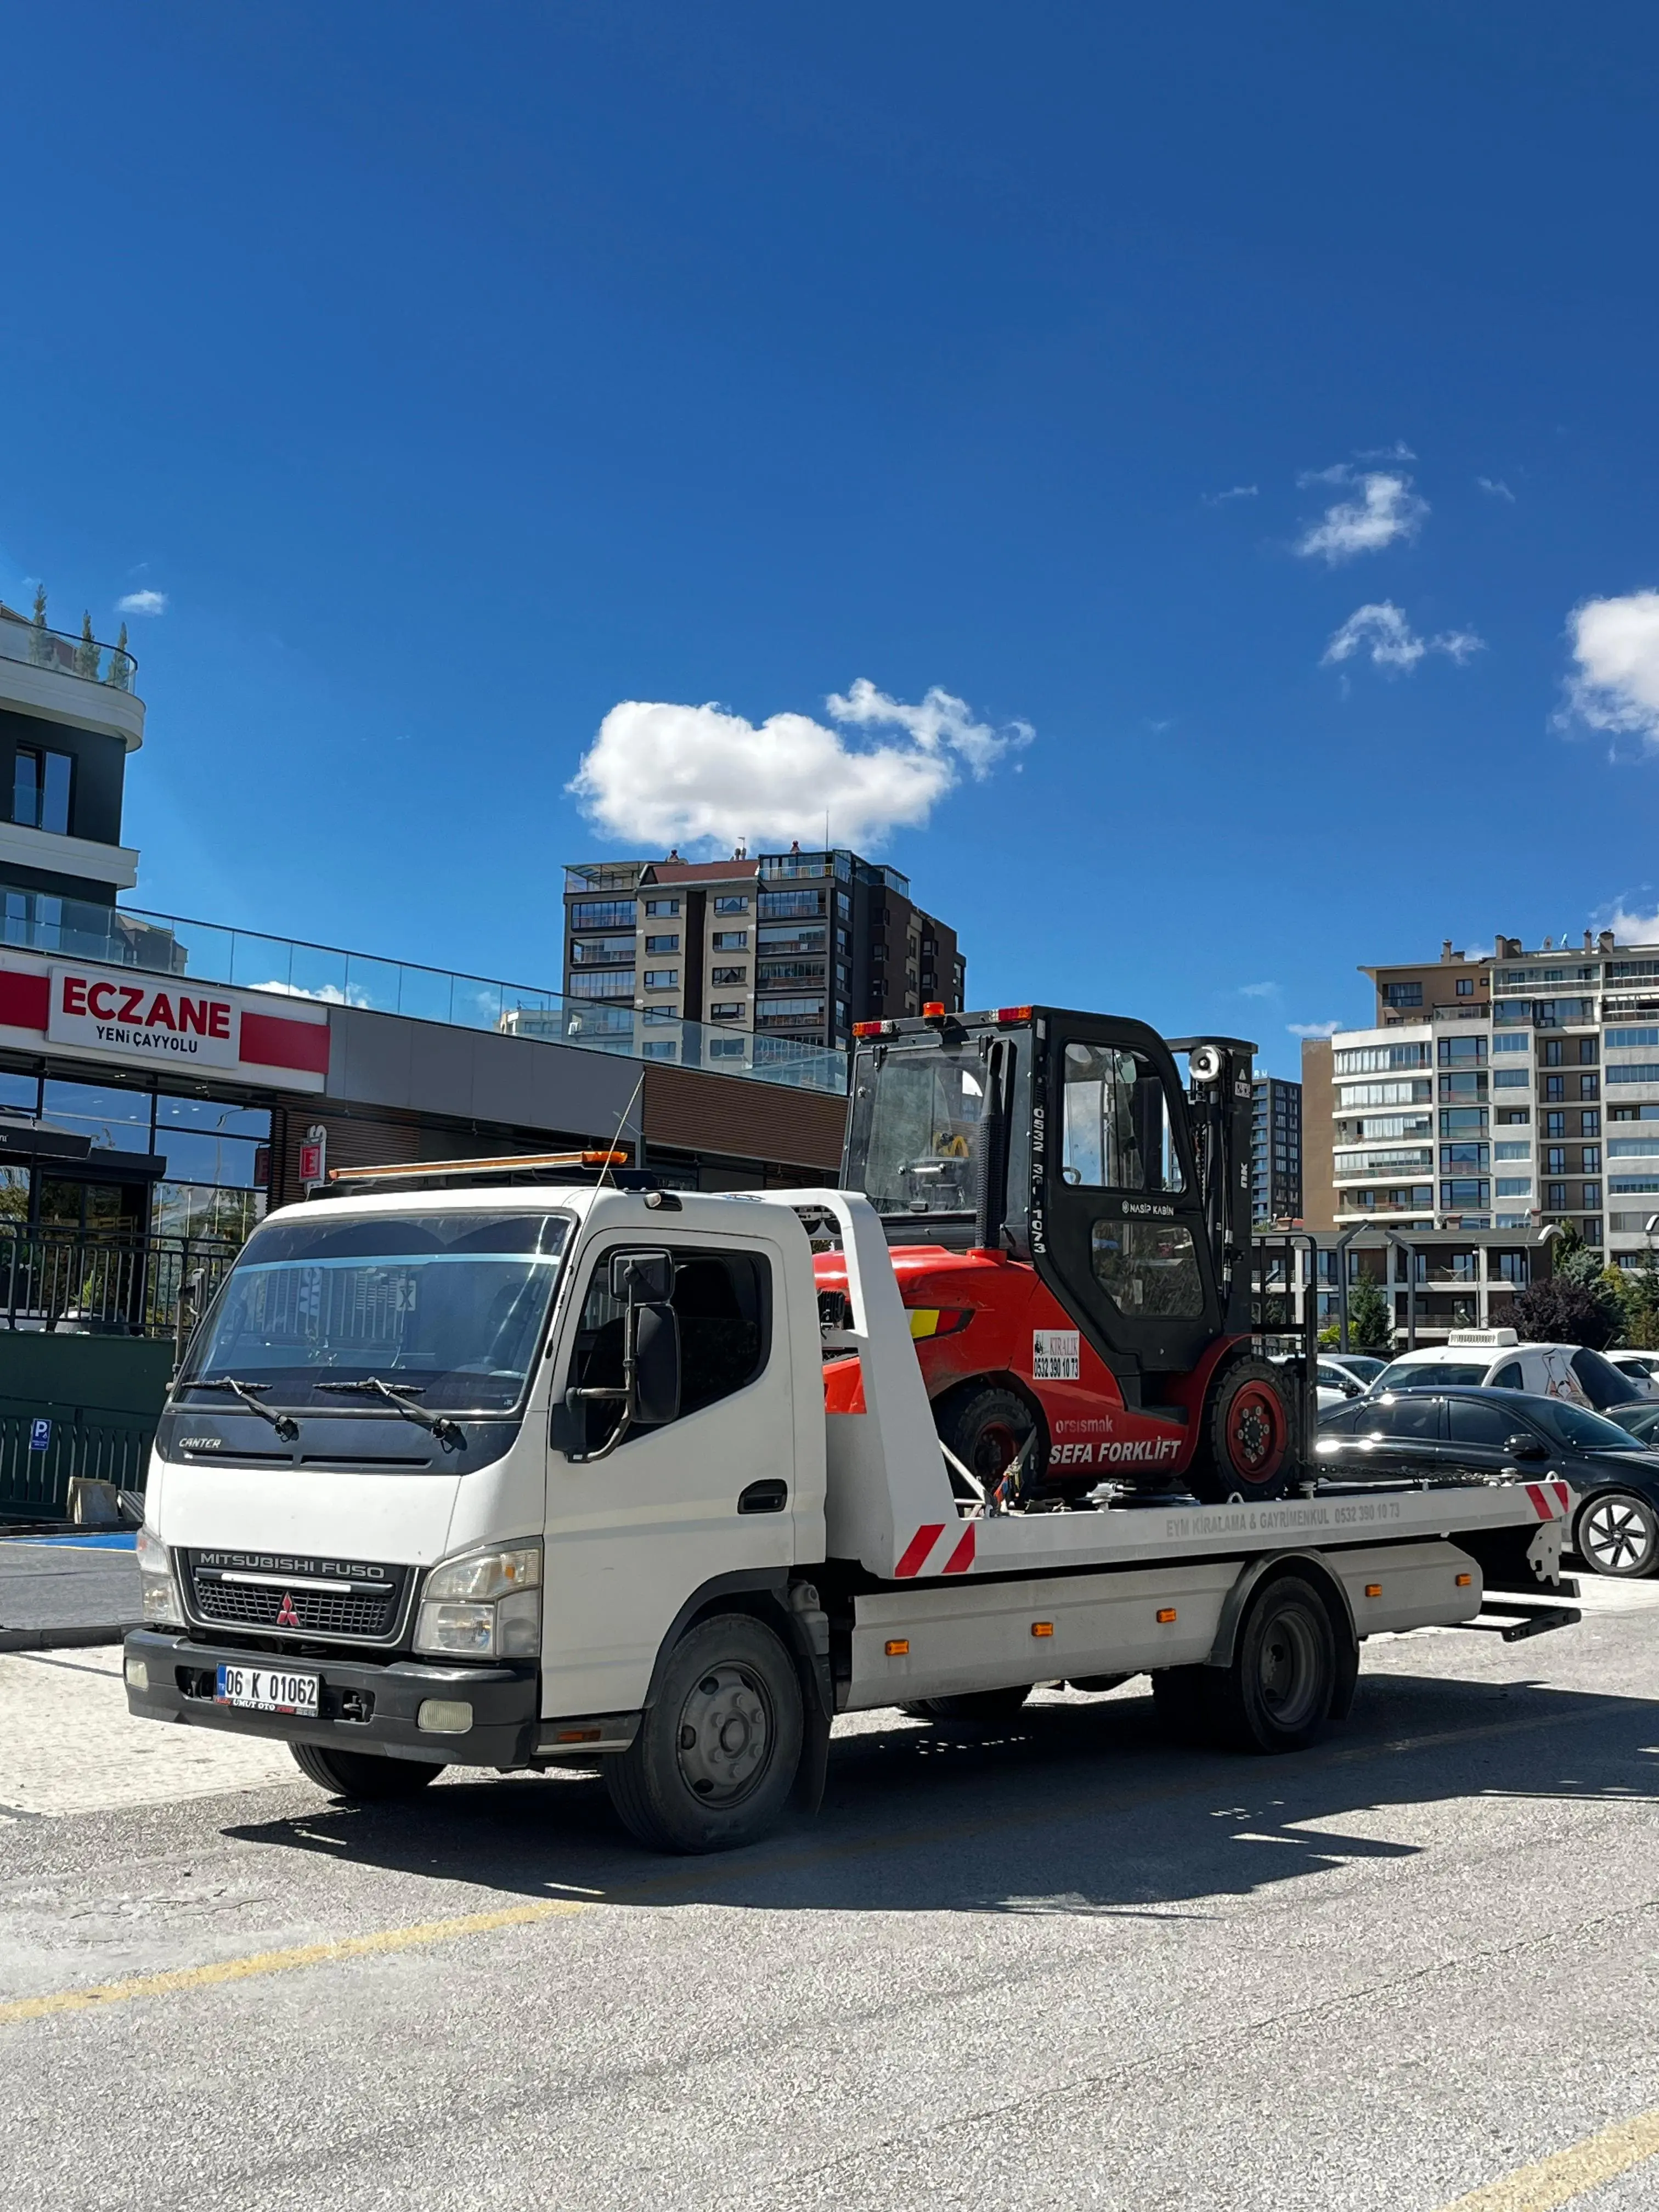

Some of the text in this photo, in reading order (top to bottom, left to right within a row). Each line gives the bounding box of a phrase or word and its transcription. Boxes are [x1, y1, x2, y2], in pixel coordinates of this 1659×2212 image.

[63, 976, 231, 1039] ECZANE
[133, 1031, 198, 1053] ÇAYYOLU
[1034, 1357, 1078, 1378] 0532 390 10 73
[35, 1421, 48, 1437] P
[179, 1438, 222, 1449] CANTER
[1049, 1435, 1181, 1464] SEFA FORKLİFT
[1166, 1519, 1189, 1537] EYM
[1249, 1513, 1256, 1530] &
[1260, 1506, 1330, 1529] GAYRİMENKUL
[1335, 1505, 1356, 1523] 0532
[1358, 1504, 1375, 1521] 390
[1377, 1503, 1387, 1519] 10
[1390, 1502, 1400, 1517] 73
[200, 1553, 384, 1578] MITSUBISHI FUSO
[227, 1670, 315, 1704] 06 K 01062
[233, 1698, 256, 1708] UMUT
[257, 1702, 275, 1712] OTO
